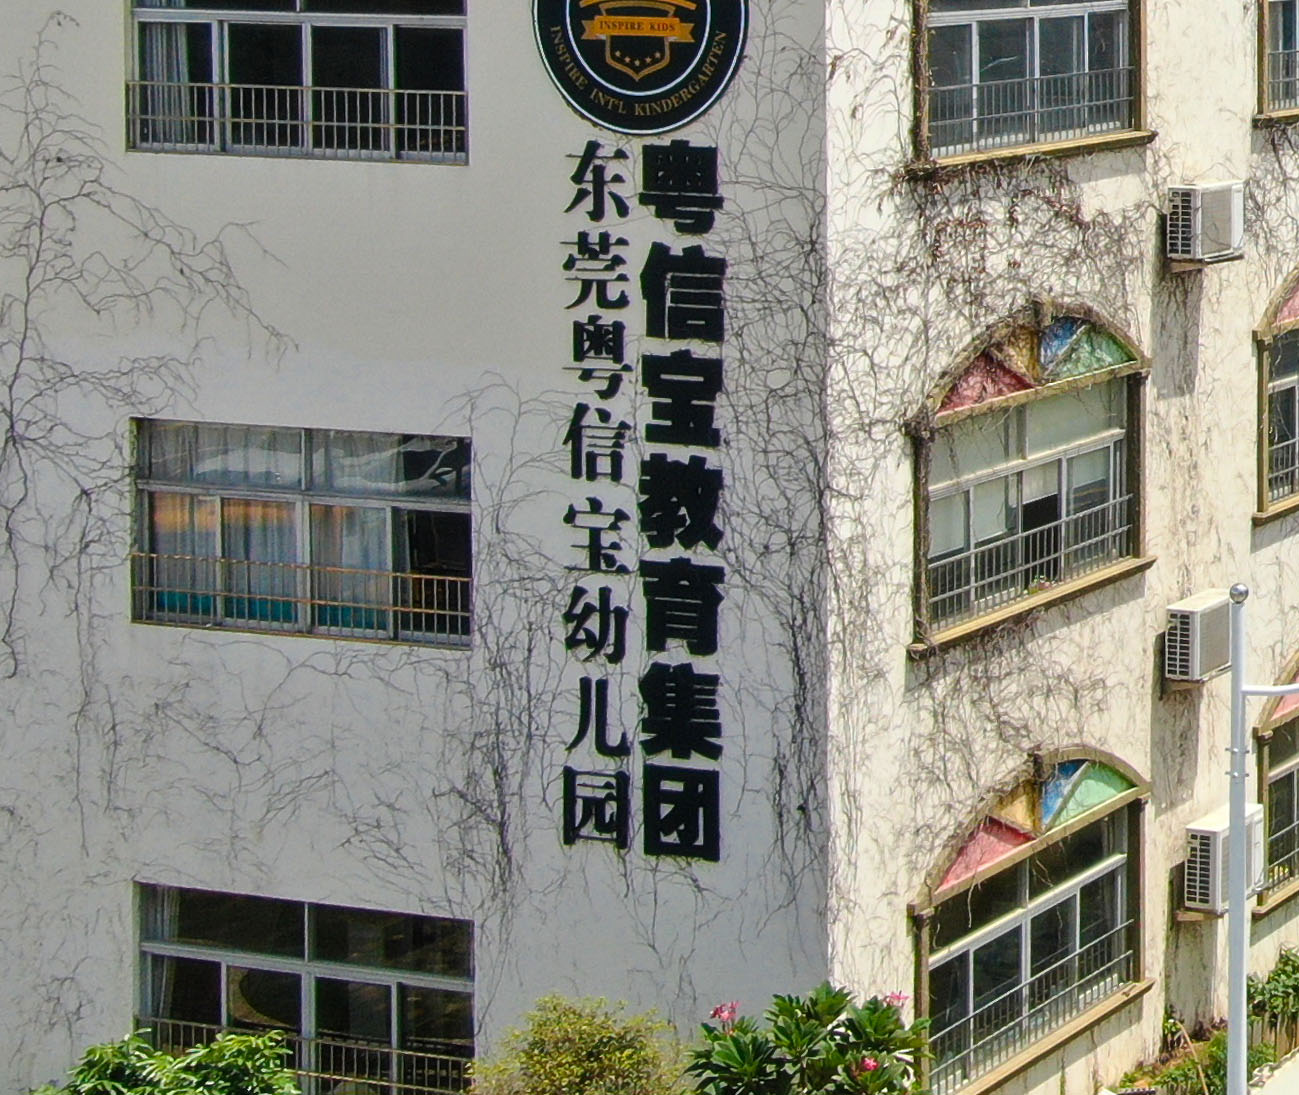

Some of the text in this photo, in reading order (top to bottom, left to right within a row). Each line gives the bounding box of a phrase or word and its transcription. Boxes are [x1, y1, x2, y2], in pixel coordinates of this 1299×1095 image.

[551, 26, 588, 89] INSPIRE
[635, 31, 728, 116] KINDERGARTEN
[599, 20, 676, 32] INSPIRE KIDS
[562, 139, 631, 851] 东莞粤信宝幼儿园
[638, 139, 725, 861] 粤信宝教育集团
